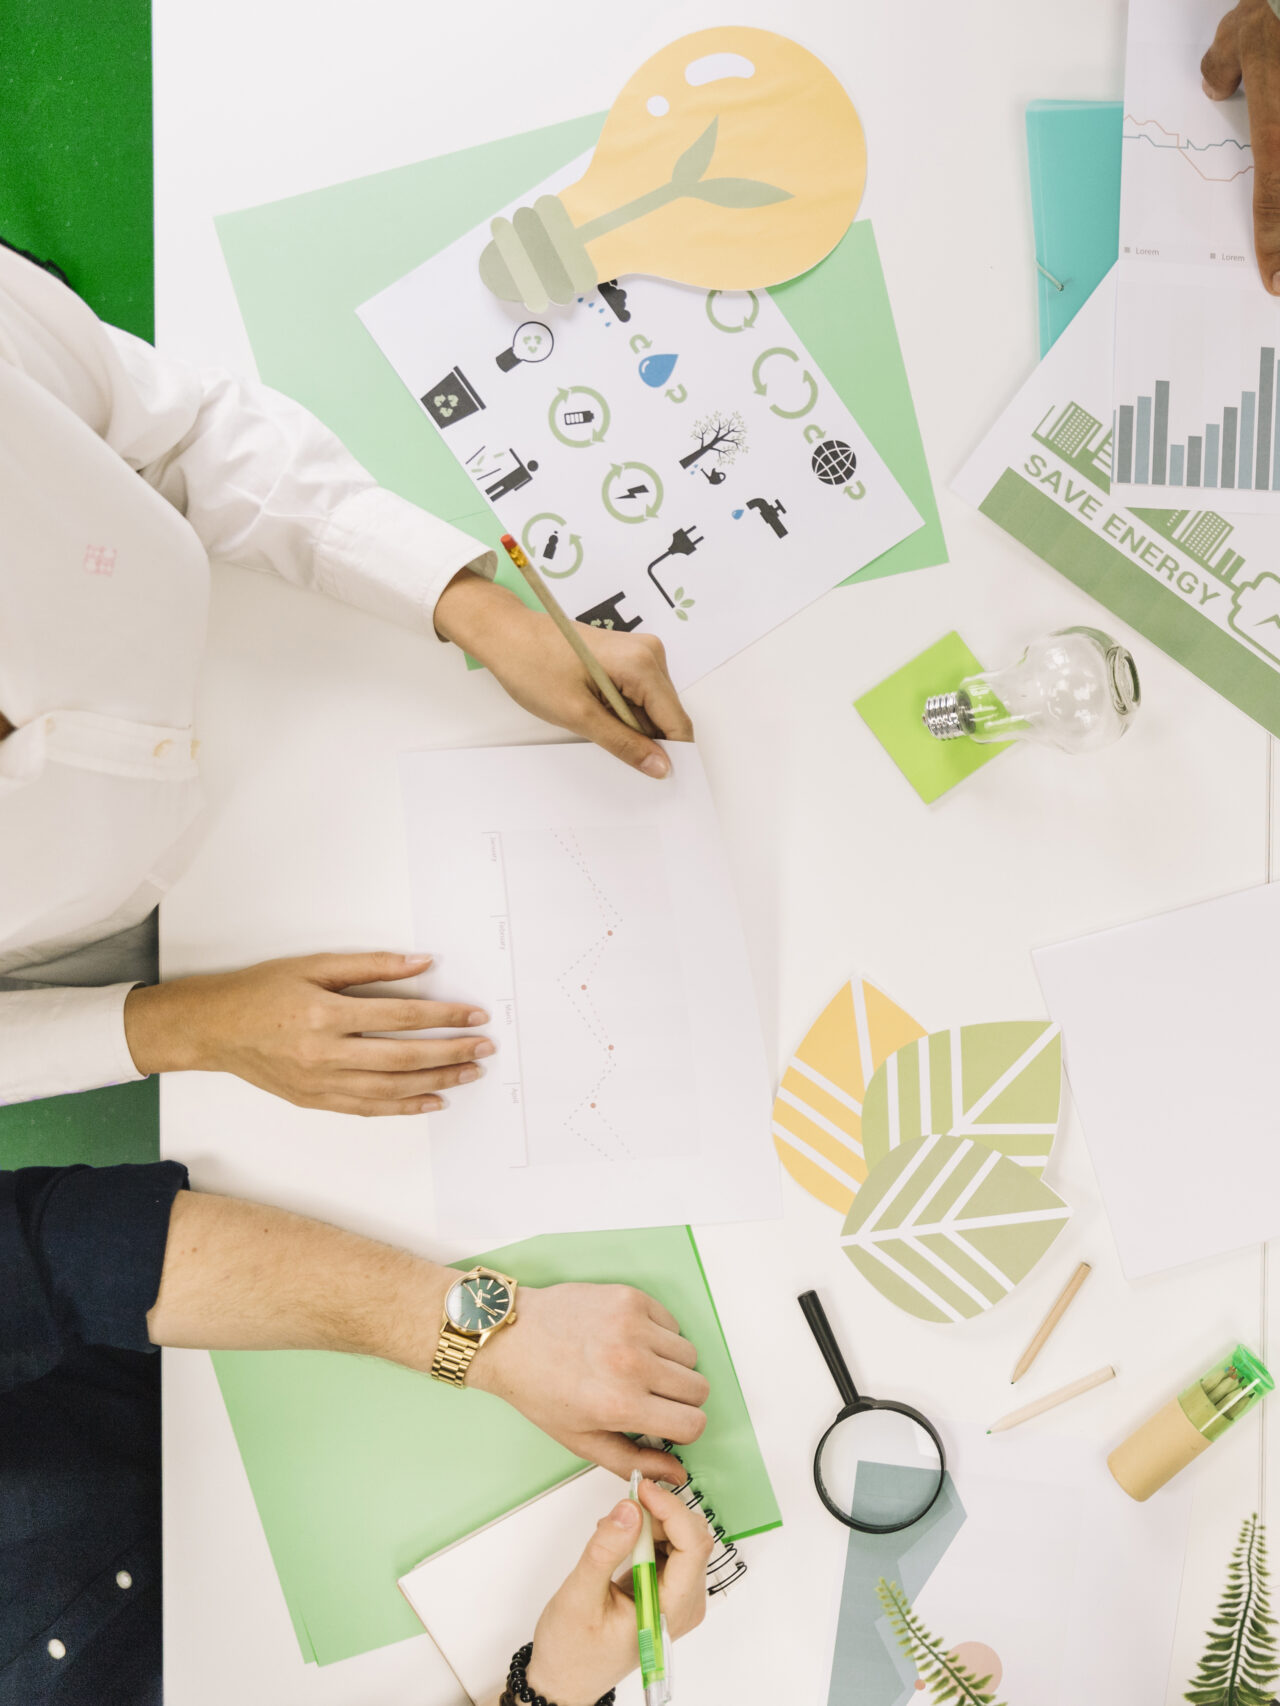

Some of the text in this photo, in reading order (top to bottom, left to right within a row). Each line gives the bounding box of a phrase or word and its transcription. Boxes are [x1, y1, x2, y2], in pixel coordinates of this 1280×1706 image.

[1135, 247, 1160, 256] Lorem
[1221, 253, 1246, 262] Lorem
[1024, 454, 1221, 606] SAVE ENERGY
[505, 1004, 513, 1025] March
